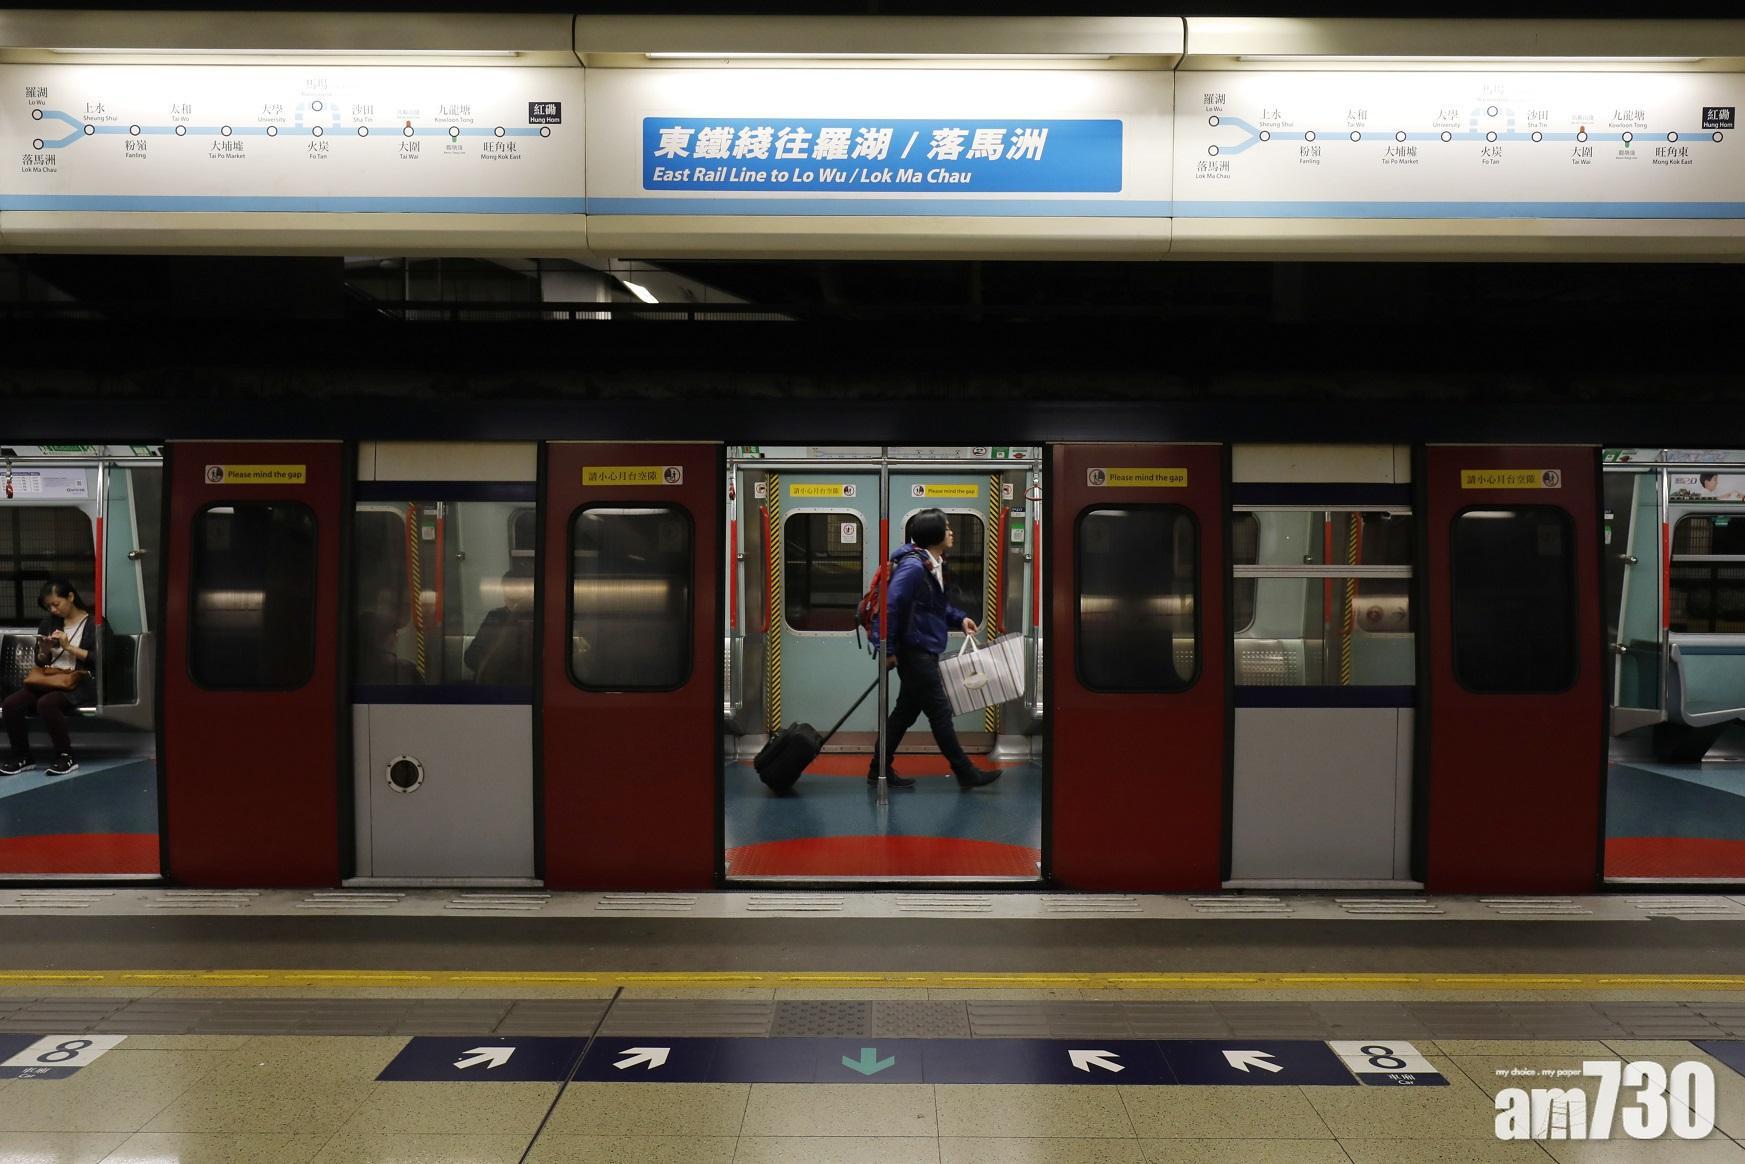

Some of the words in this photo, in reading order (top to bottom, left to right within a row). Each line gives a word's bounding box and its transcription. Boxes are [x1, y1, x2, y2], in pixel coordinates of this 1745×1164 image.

[25, 87, 48, 98] 羅湖
[1204, 93, 1225, 104] 羅湖
[84, 103, 105, 113] 上水
[171, 104, 191, 114] 太和
[352, 105, 373, 115] 沙田
[1261, 109, 1281, 119] 上水
[1347, 109, 1367, 120] 太和
[1527, 110, 1548, 120] 沙田
[1612, 109, 1645, 121] 九龍塘
[125, 140, 147, 151] 粉嶺
[211, 141, 244, 152] 大埔墟
[307, 141, 329, 152] 火炭
[399, 141, 420, 152] 大圍
[483, 141, 516, 152] 旺角東
[653, 126, 894, 160] 東鐵綫往羅湖
[901, 132, 918, 159] /
[926, 128, 1048, 161] 落馬洲
[1300, 146, 1321, 157] 粉嶺
[1385, 147, 1417, 157] 大埔墟
[1481, 147, 1502, 157] 火炭
[1571, 146, 1592, 158] 大圍
[1656, 147, 1688, 157] 旺角東
[22, 154, 56, 166] 落馬洲
[1197, 161, 1230, 172] 落馬洲
[653, 167, 690, 182] East
[693, 167, 726, 183] Rail
[729, 168, 767, 183] Line
[771, 169, 788, 183] to
[794, 168, 814, 183] Lo
[818, 168, 846, 183] Wu
[850, 168, 858, 184] /
[861, 168, 892, 183] Lok
[895, 169, 924, 184] Ma
[927, 168, 971, 184] Chau
[228, 470, 251, 478] Please
[253, 470, 272, 479] mind
[274, 470, 286, 479] the
[288, 472, 302, 481] gap
[589, 472, 657, 481] 請小心月台空隙
[1169, 475, 1184, 483] gap
[1467, 475, 1535, 484] 請小心月台空隙
[37, 1040, 93, 1062] 8
[1361, 1045, 1406, 1069] 8
